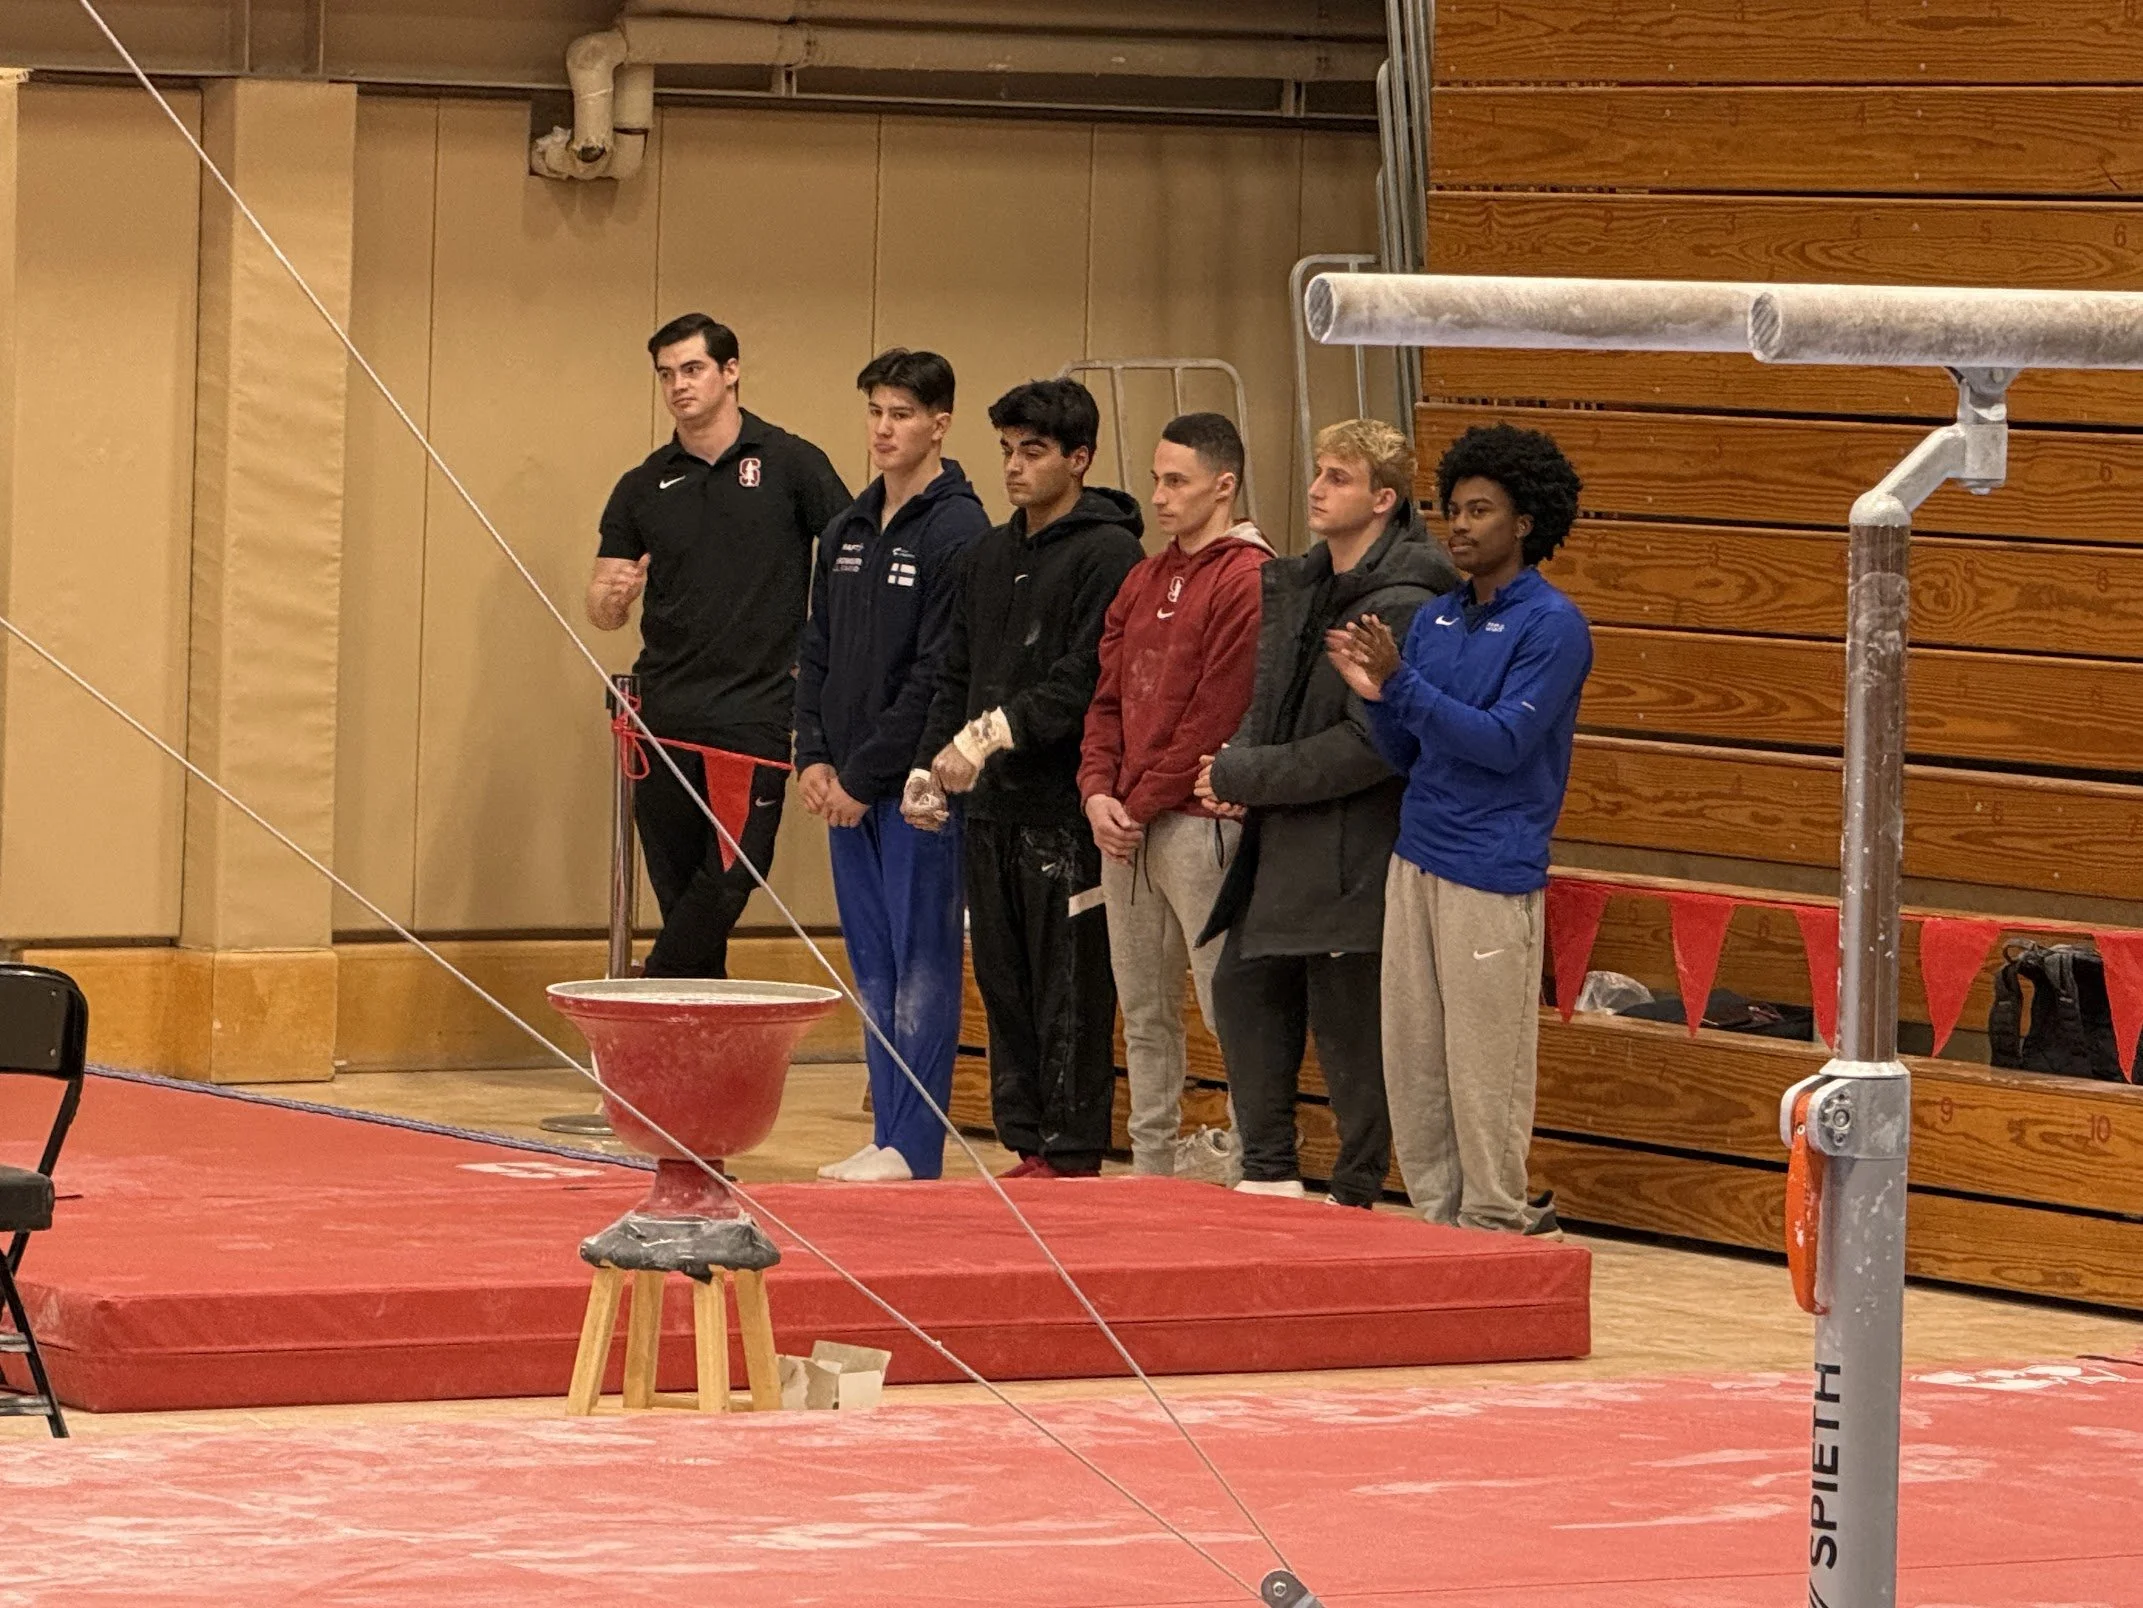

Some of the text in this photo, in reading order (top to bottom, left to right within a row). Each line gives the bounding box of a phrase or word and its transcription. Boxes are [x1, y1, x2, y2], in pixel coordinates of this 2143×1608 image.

[2113, 223, 2127, 248] 6
[1940, 1096, 2112, 1144] 9 10
[1810, 1362, 1841, 1570] SPIETH
